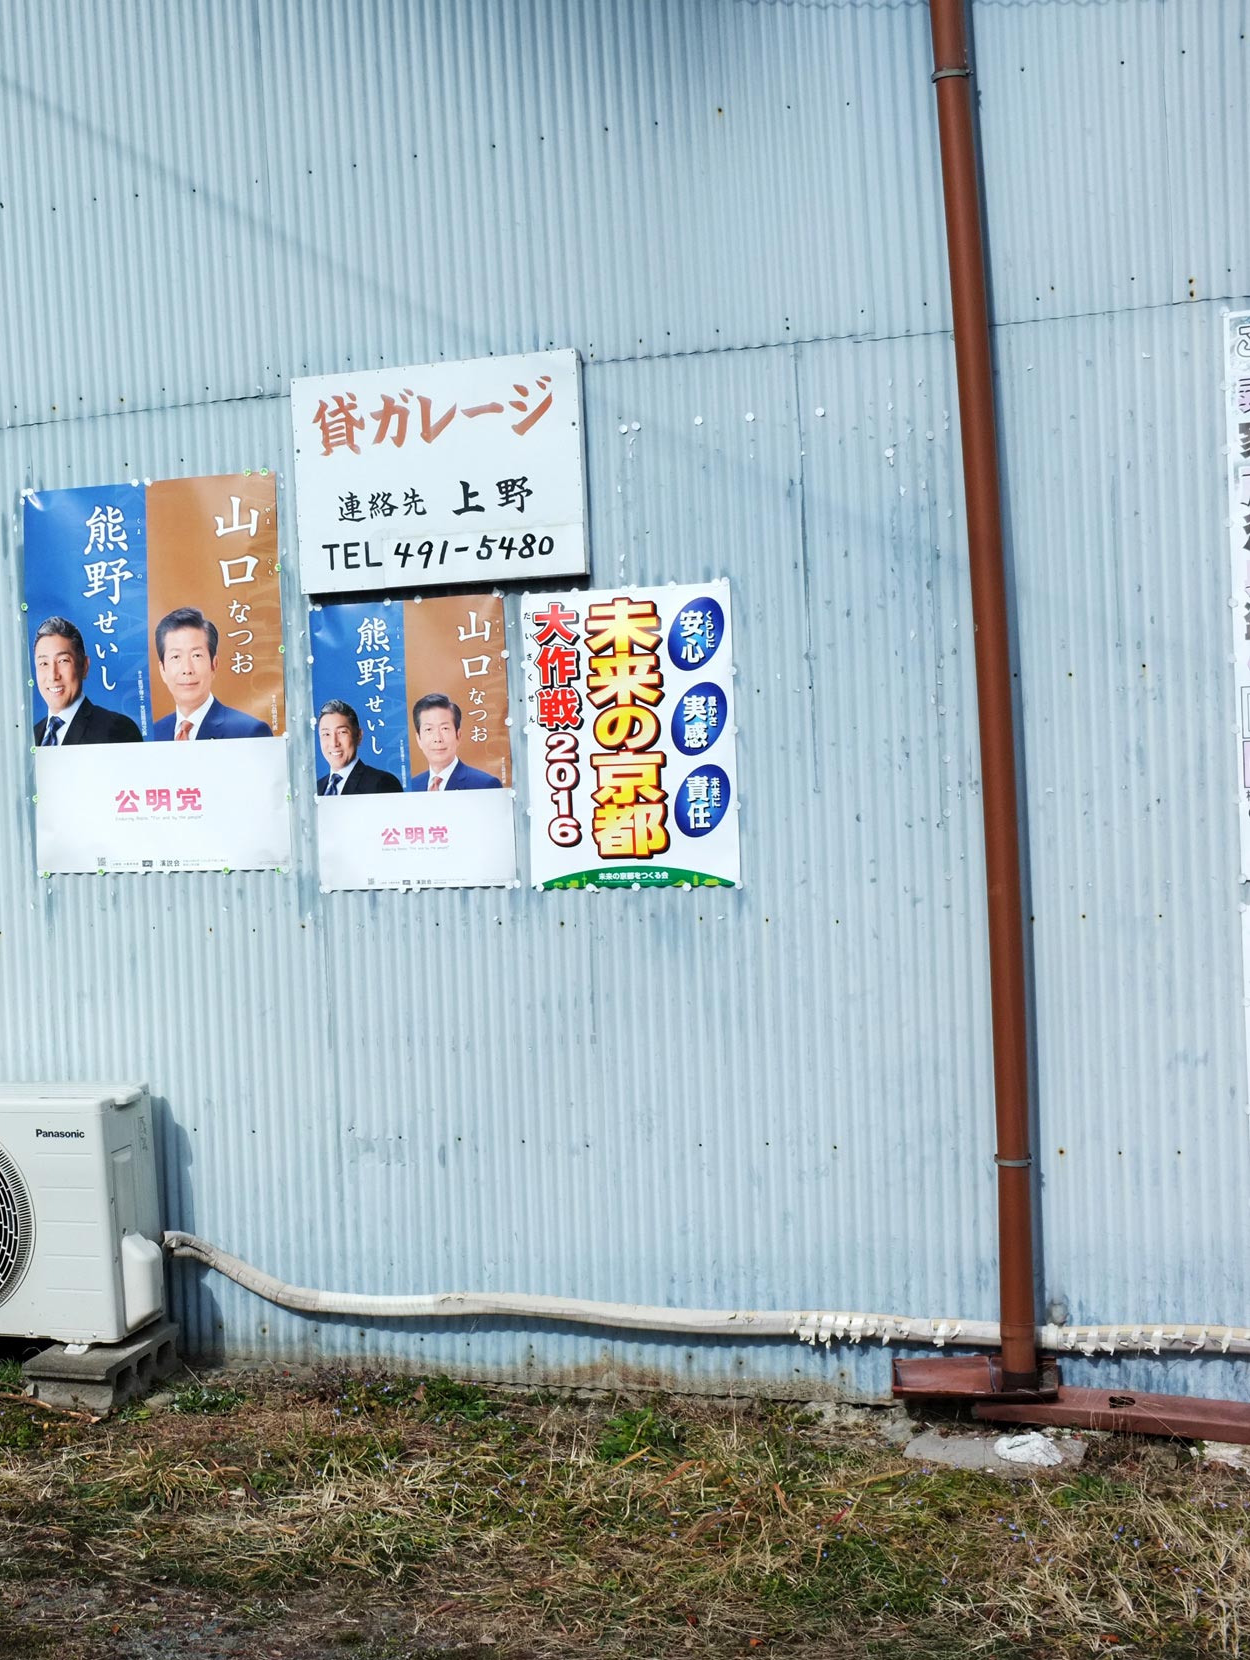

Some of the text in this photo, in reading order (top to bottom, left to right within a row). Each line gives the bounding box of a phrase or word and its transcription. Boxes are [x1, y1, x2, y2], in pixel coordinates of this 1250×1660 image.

[312, 375, 553, 457] 貸ガレージ
[338, 476, 534, 523] 連絡先 上野
[321, 533, 555, 571] TEL 491-5480
[679, 609, 706, 665] 安心
[705, 609, 716, 649] くらしに
[586, 597, 671, 860] 未来の京都
[682, 694, 708, 749] 実感
[115, 787, 202, 813] 公明党
[686, 775, 711, 830] 責任
[381, 825, 449, 846] 公明党
[35, 1128, 86, 1139] Panasonic
